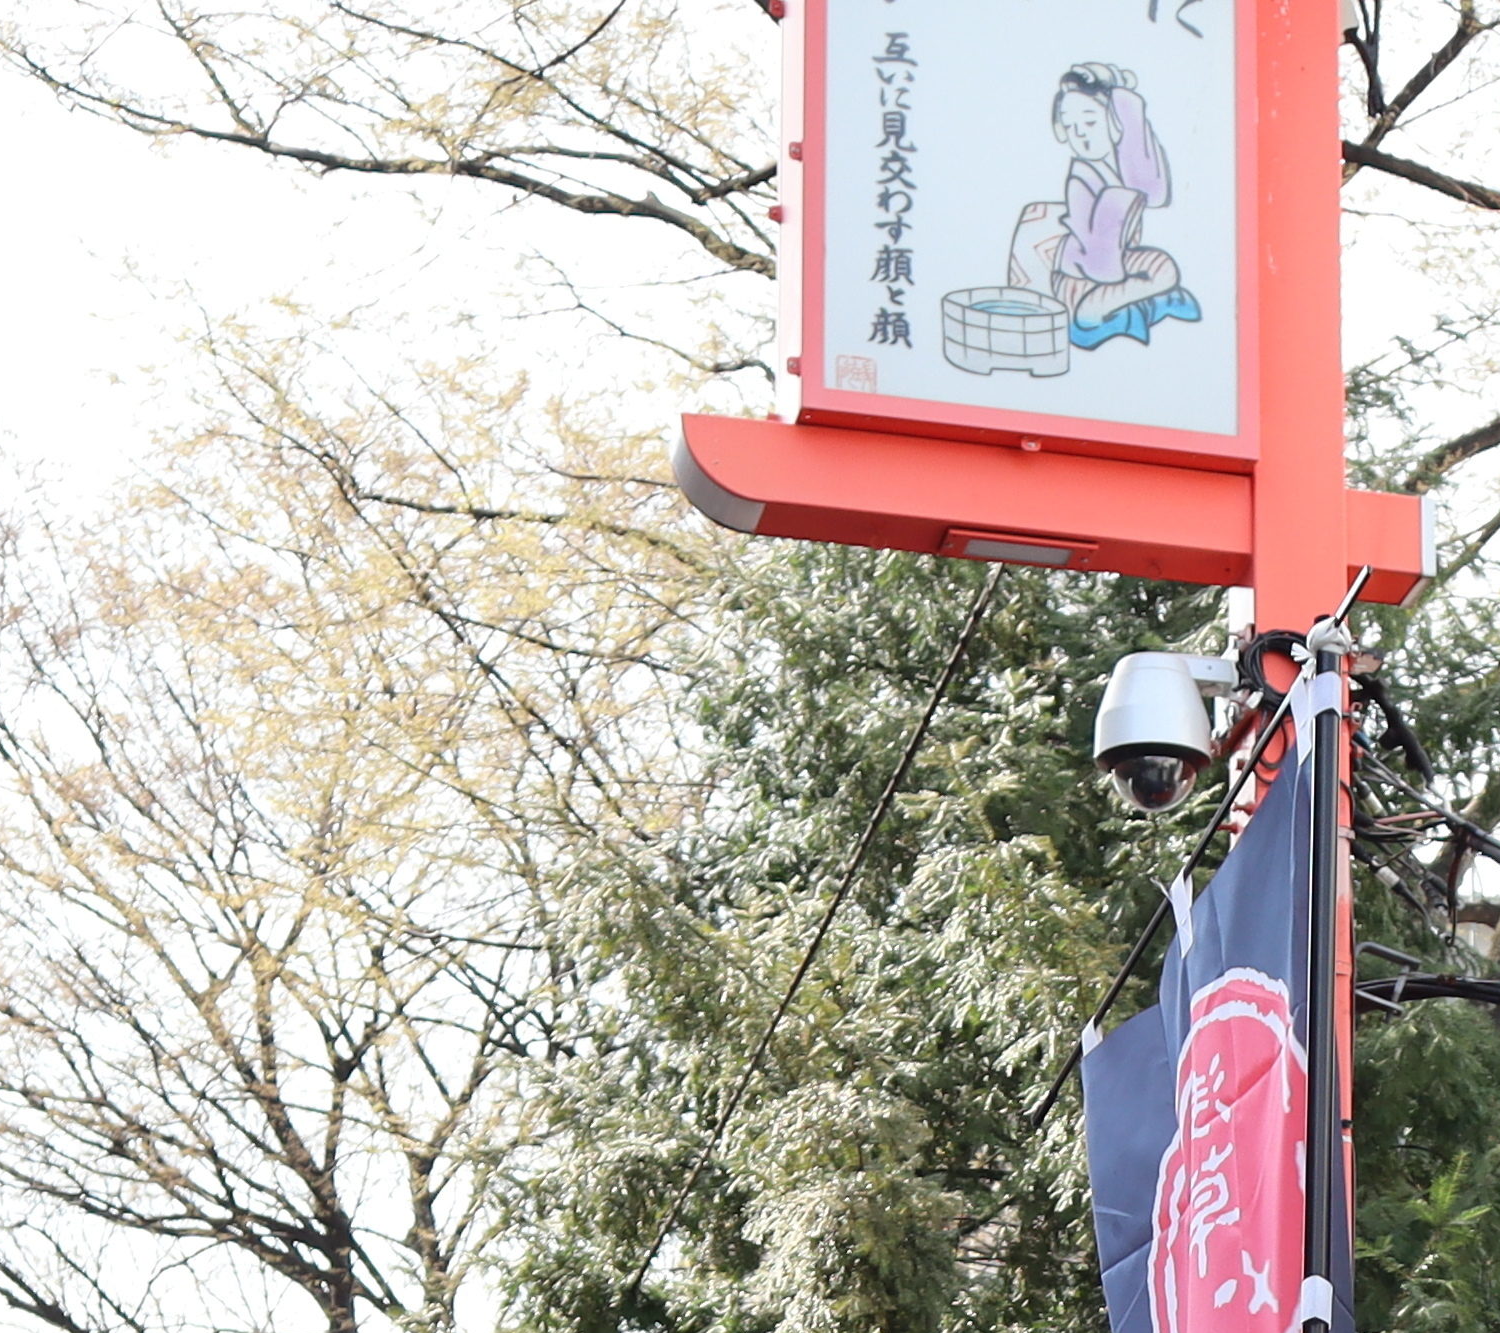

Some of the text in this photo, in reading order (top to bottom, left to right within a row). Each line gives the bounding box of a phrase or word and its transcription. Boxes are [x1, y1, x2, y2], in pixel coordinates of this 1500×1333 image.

[866, 30, 919, 350] 互いに見交わす顔と顔
